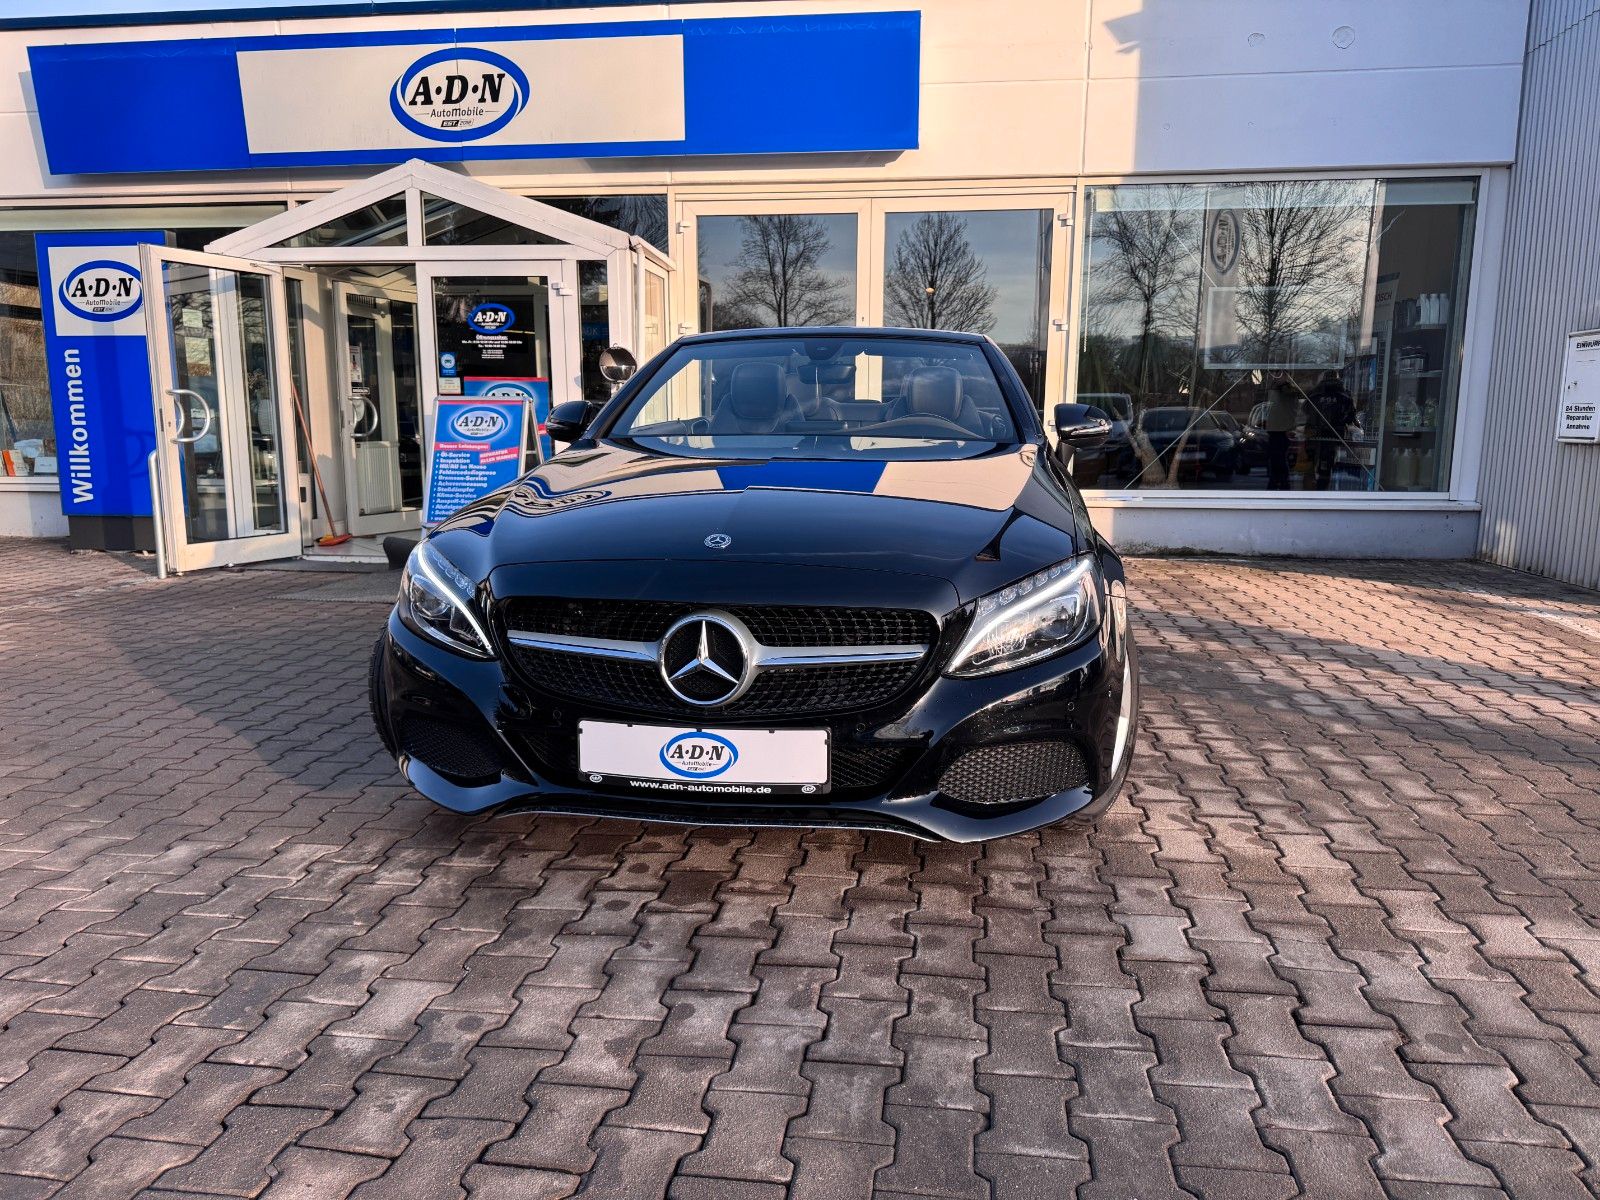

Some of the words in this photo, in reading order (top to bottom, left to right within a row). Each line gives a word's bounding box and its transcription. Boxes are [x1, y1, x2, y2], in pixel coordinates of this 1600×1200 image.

[430, 107, 484, 118] AutoMobile
[63, 348, 94, 504] Willkommen
[629, 779, 772, 795] www.adn-automobile.de
